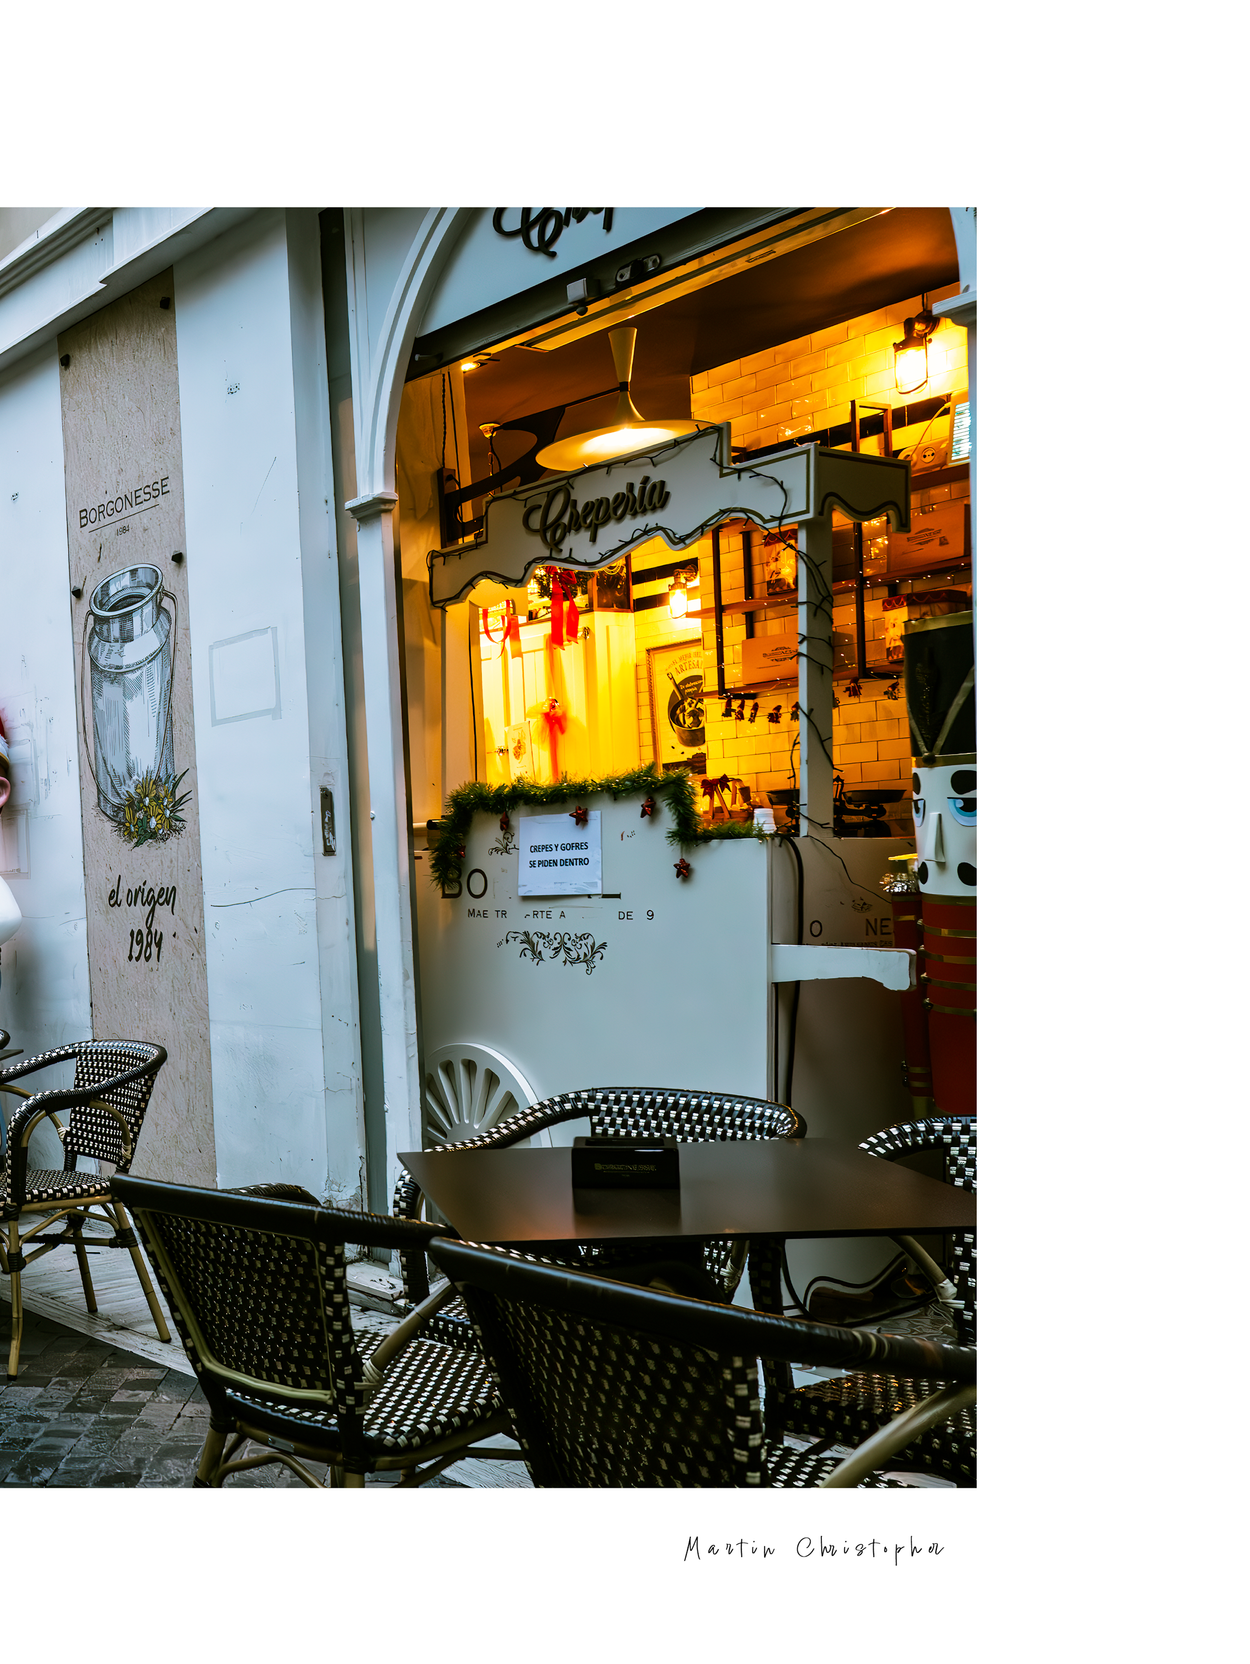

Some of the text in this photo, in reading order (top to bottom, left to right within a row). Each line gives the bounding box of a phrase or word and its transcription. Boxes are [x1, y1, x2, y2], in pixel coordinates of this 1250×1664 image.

[77, 476, 170, 529] BORGONESSE
[522, 475, 670, 553] Crepería
[528, 857, 590, 869] SE PIDEN DENTRO
[529, 841, 589, 854] CREPES Y GOFRES
[108, 874, 177, 931] el origen
[127, 928, 163, 963] 1984
